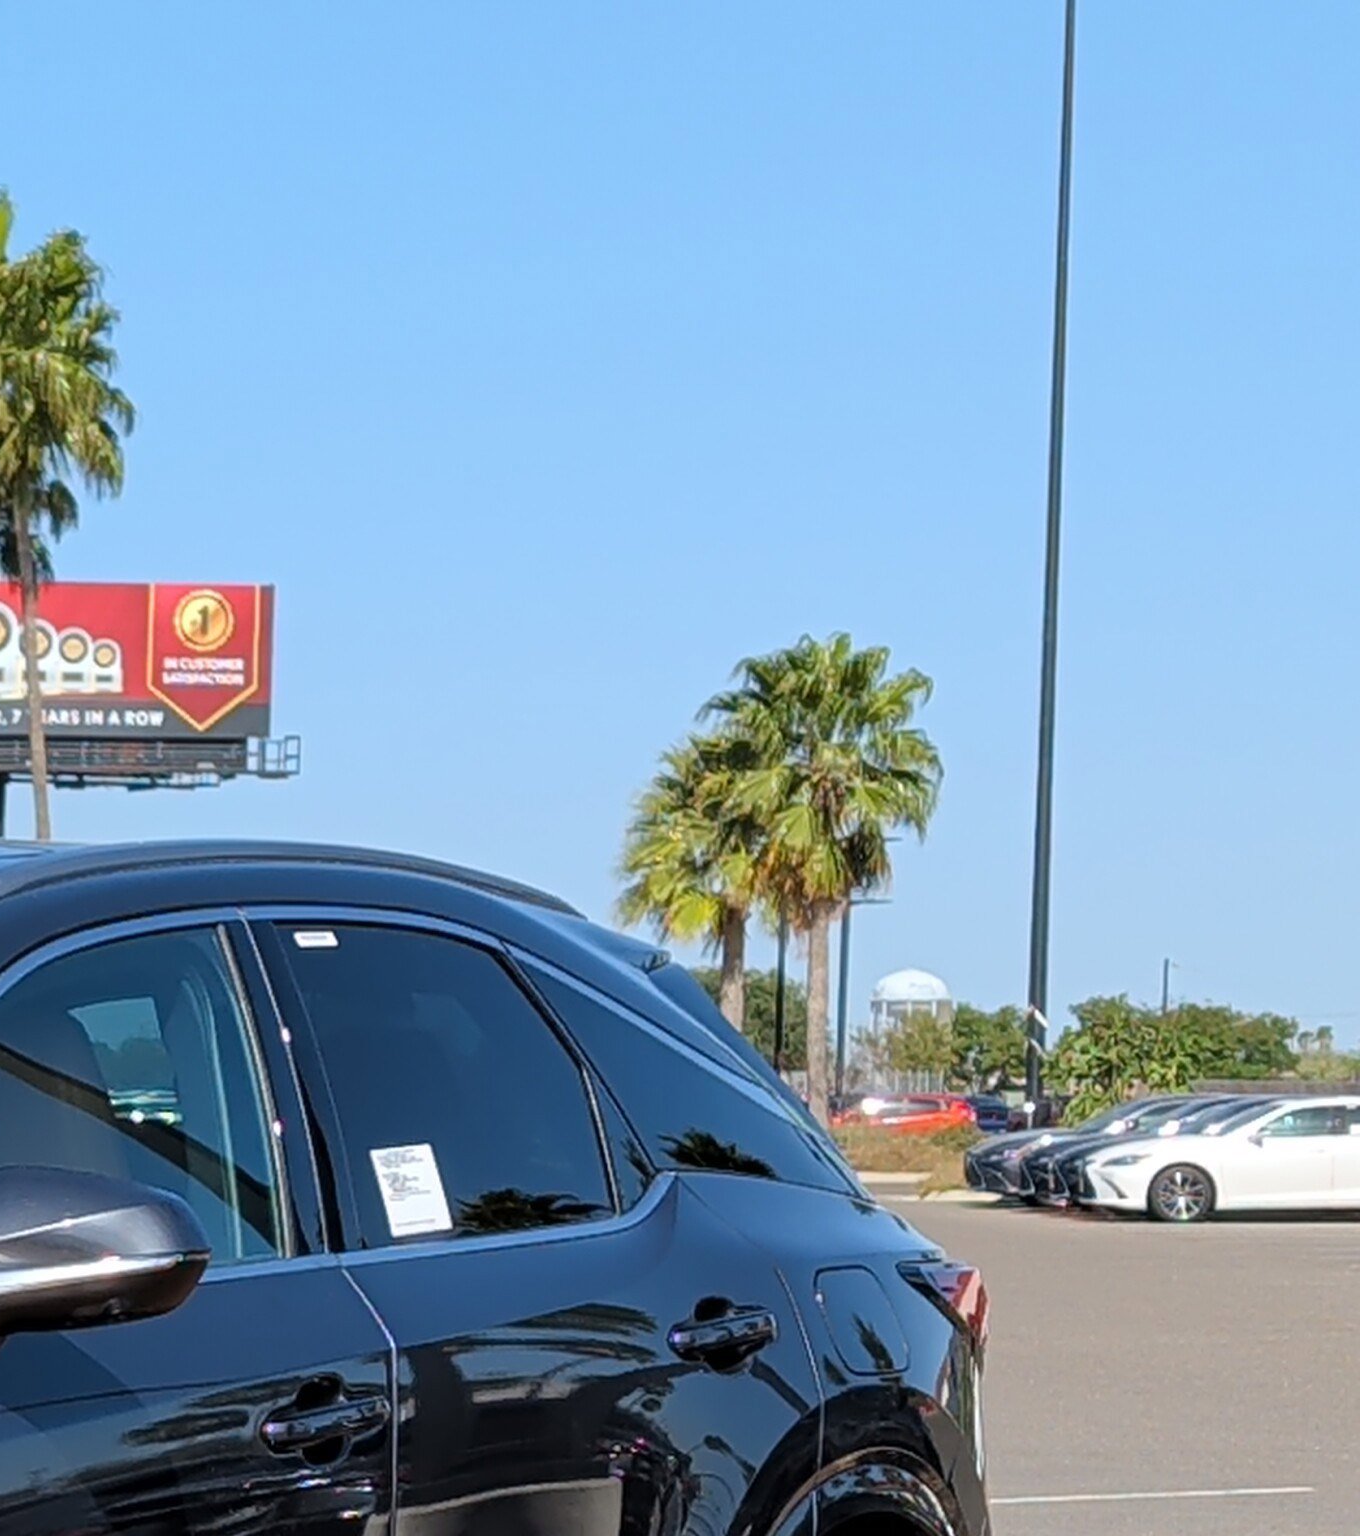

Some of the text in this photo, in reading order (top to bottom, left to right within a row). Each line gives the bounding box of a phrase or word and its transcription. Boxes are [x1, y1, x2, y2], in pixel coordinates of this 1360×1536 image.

[181, 657, 244, 671] CUSTOMER
[84, 711, 104, 726] IN
[108, 711, 120, 726] A
[124, 711, 164, 728] ROW
